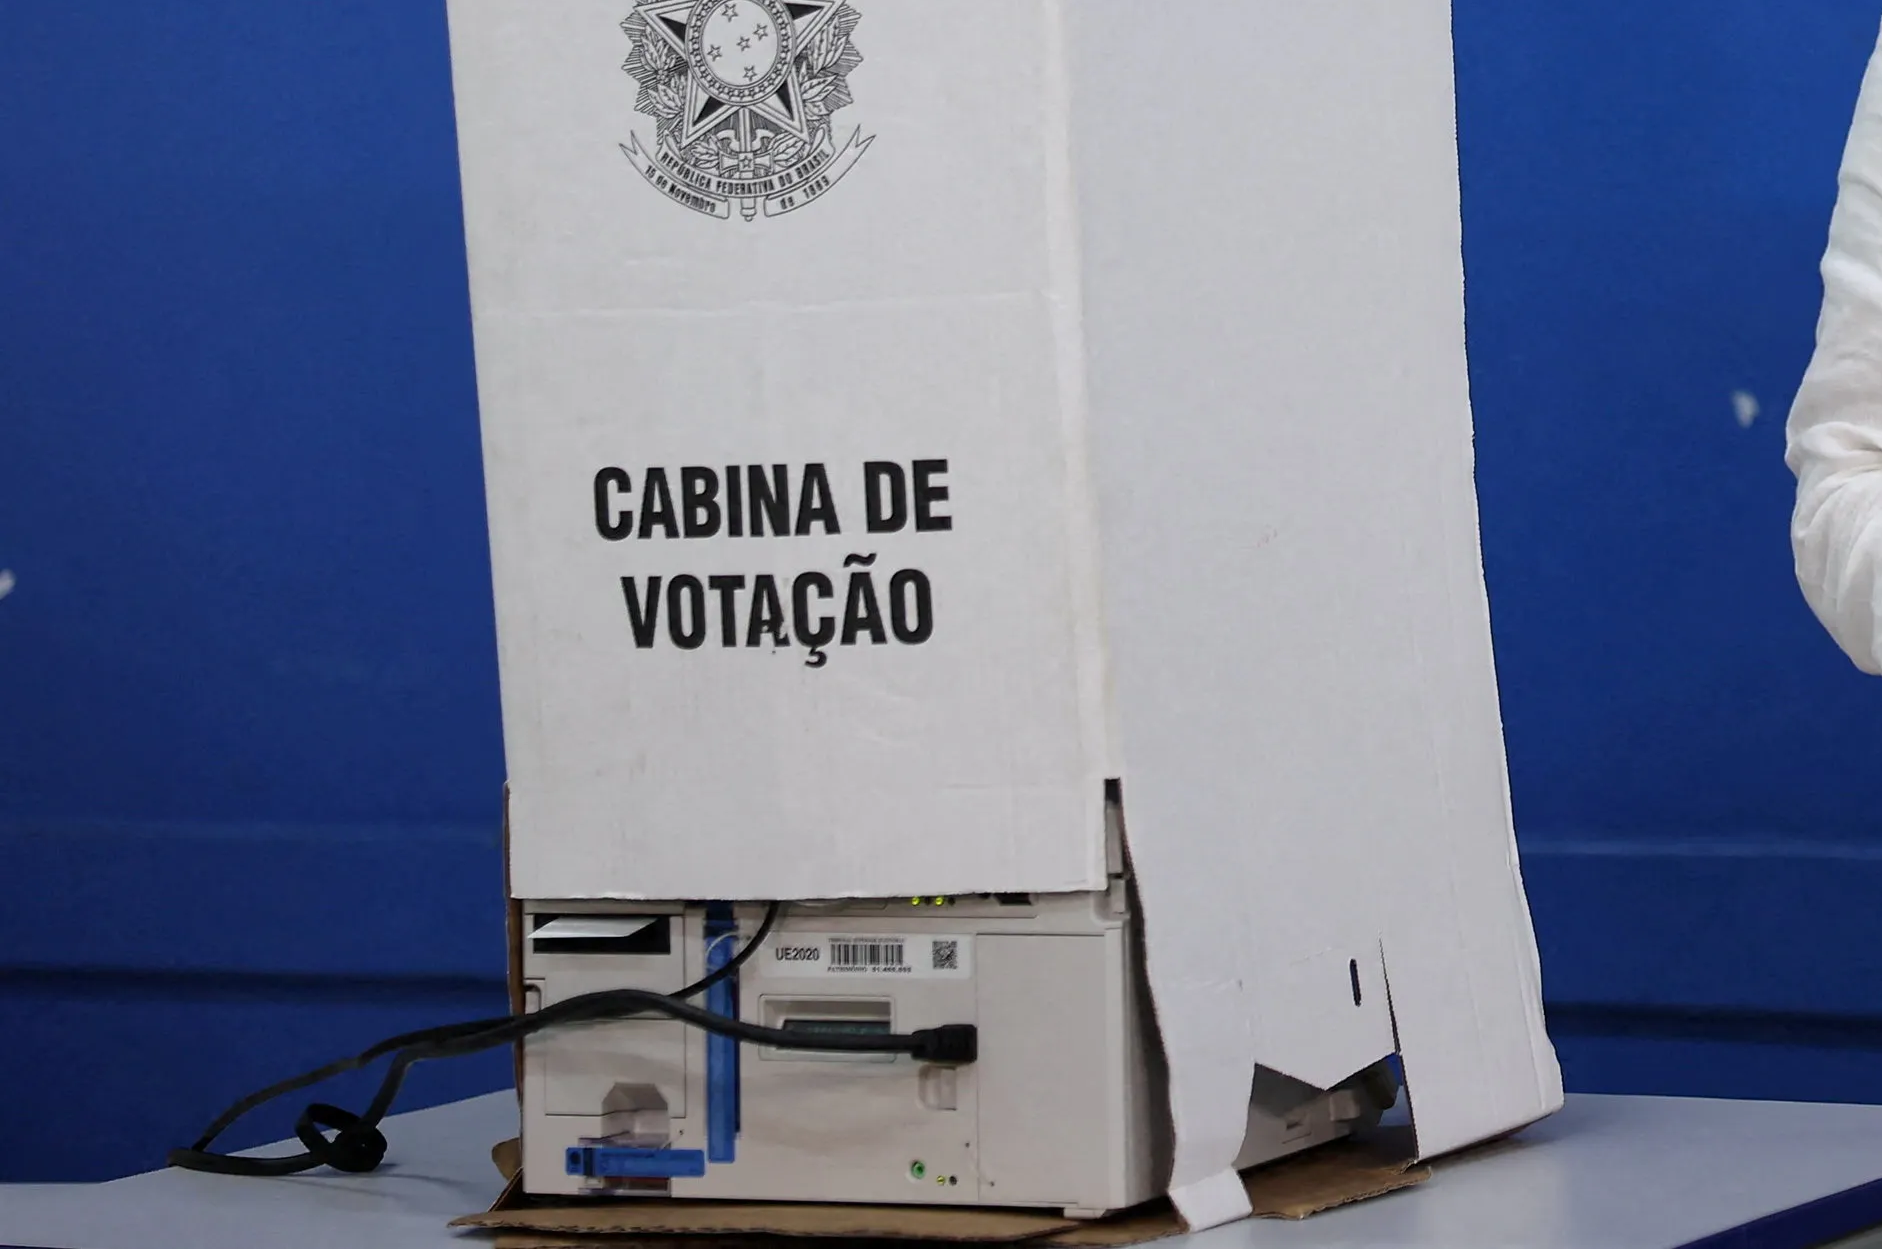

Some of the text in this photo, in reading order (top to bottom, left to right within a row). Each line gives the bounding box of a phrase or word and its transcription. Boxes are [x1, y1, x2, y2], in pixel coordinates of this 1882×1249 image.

[645, 164, 656, 179] 15
[668, 183, 716, 213] Novembro
[660, 151, 711, 190] REPÚBLICA
[716, 178, 774, 195] FEDERATIVA
[593, 458, 953, 542] CABINA DE
[619, 552, 934, 669] VOTAÇÃO
[776, 946, 820, 961] UE2020
